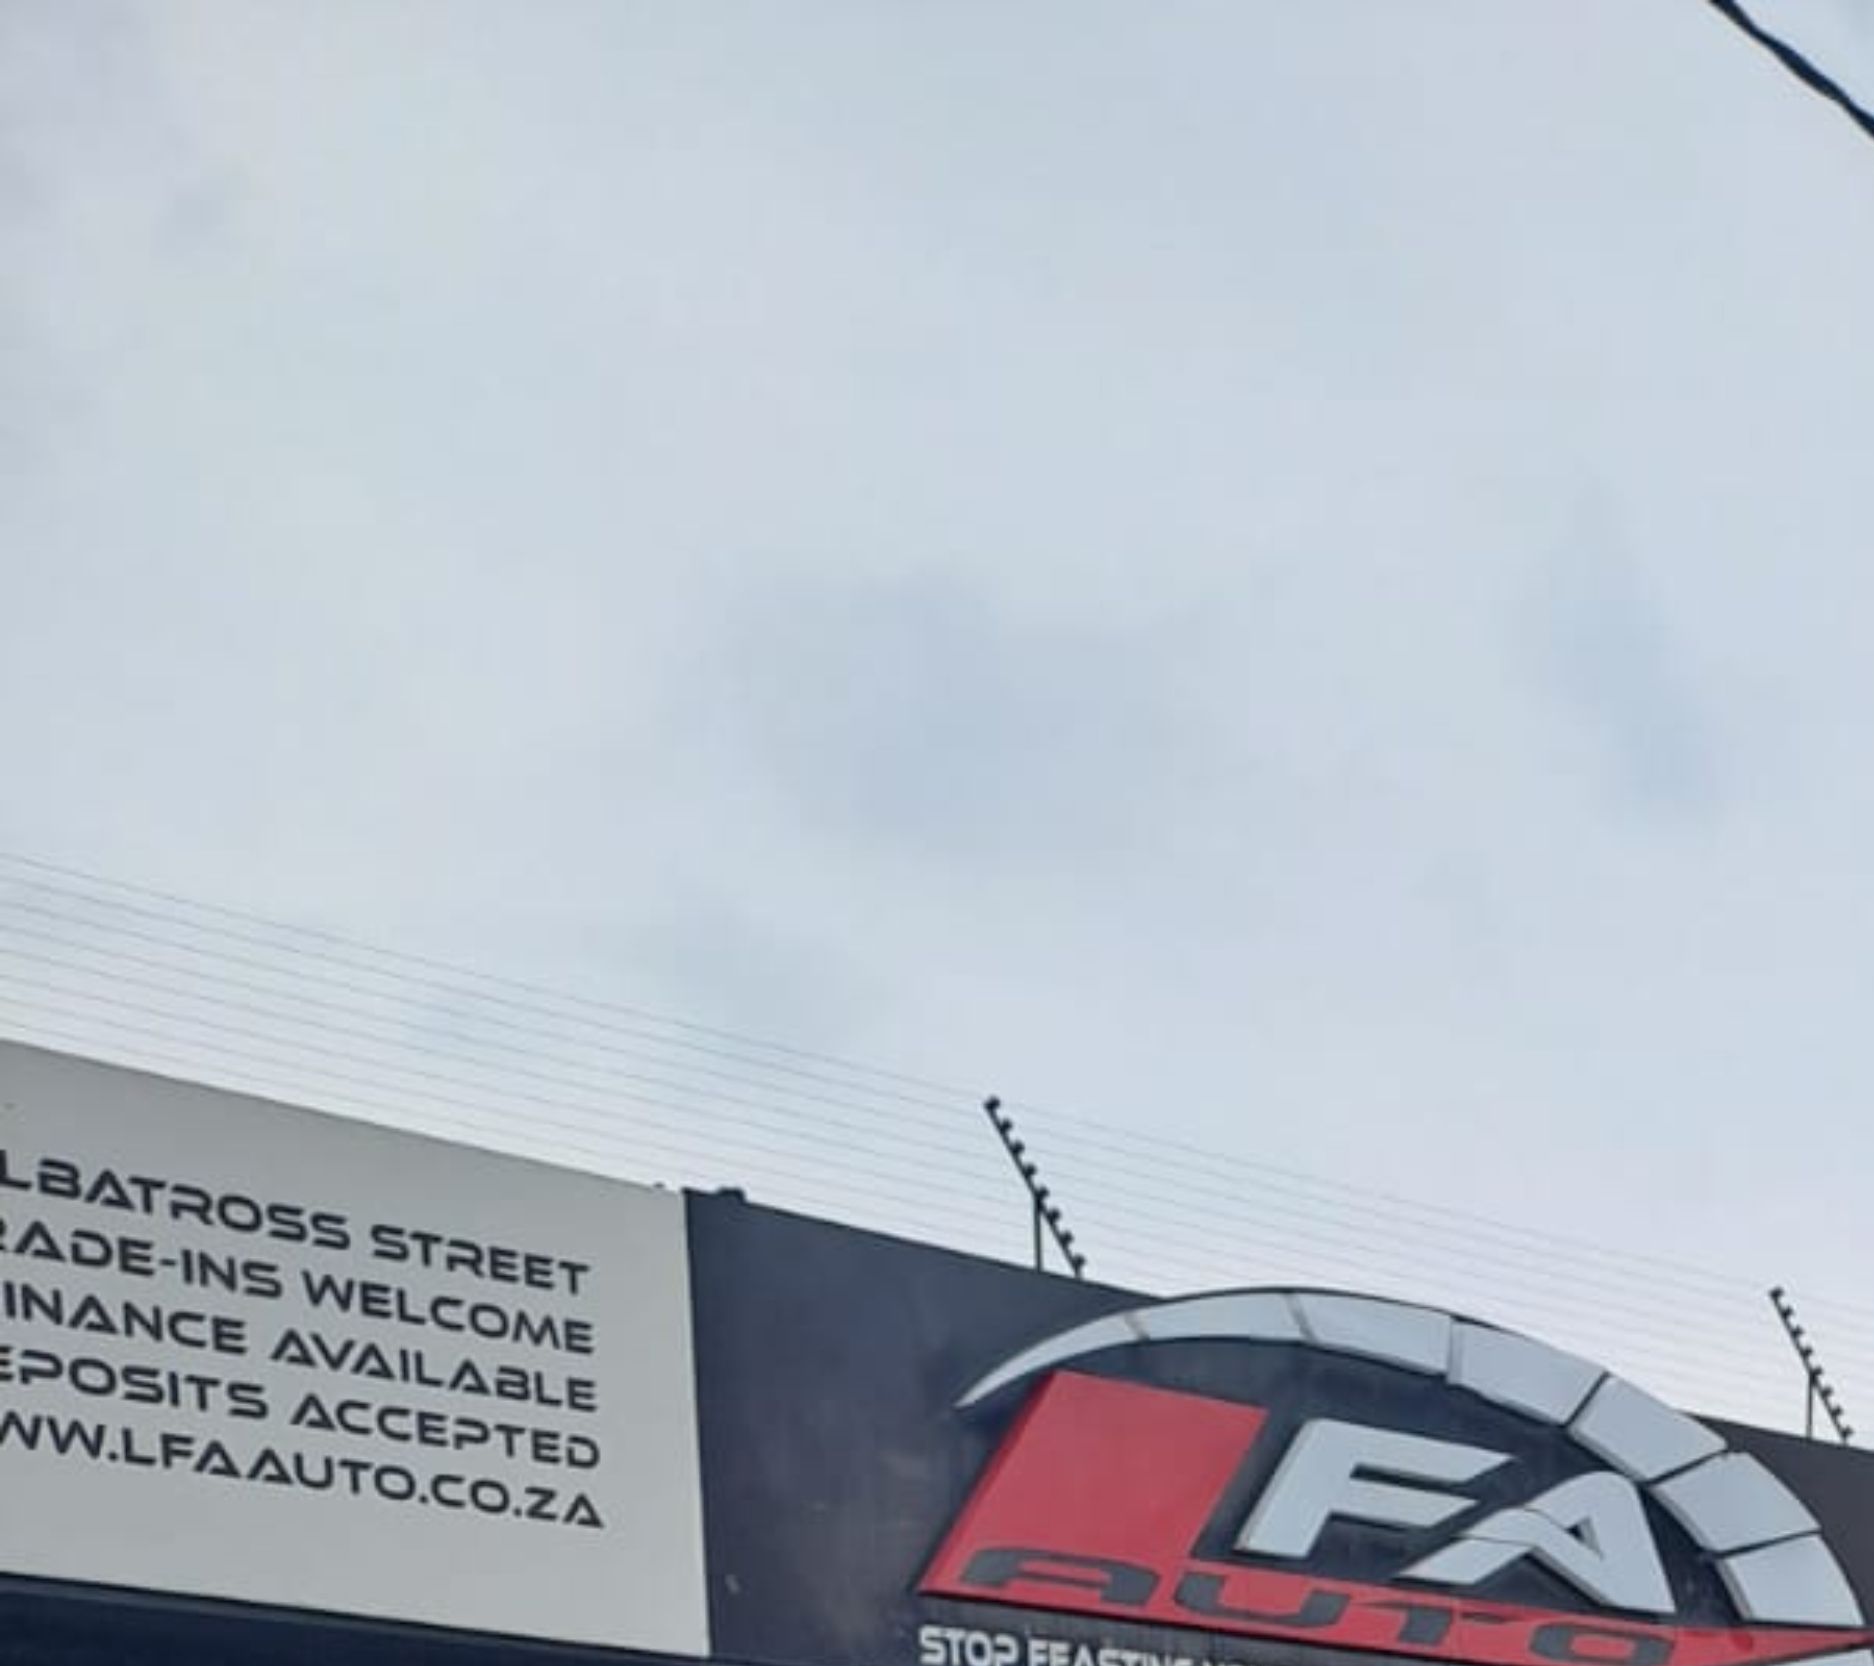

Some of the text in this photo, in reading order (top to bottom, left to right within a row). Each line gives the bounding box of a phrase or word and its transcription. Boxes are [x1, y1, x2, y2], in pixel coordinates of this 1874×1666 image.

[0, 1218, 593, 1353] ADE-INS WELCOME
[372, 1225, 590, 1295] STREET
[270, 1330, 597, 1412] AVAILABLE
[291, 1393, 600, 1469] ACCEPTED
